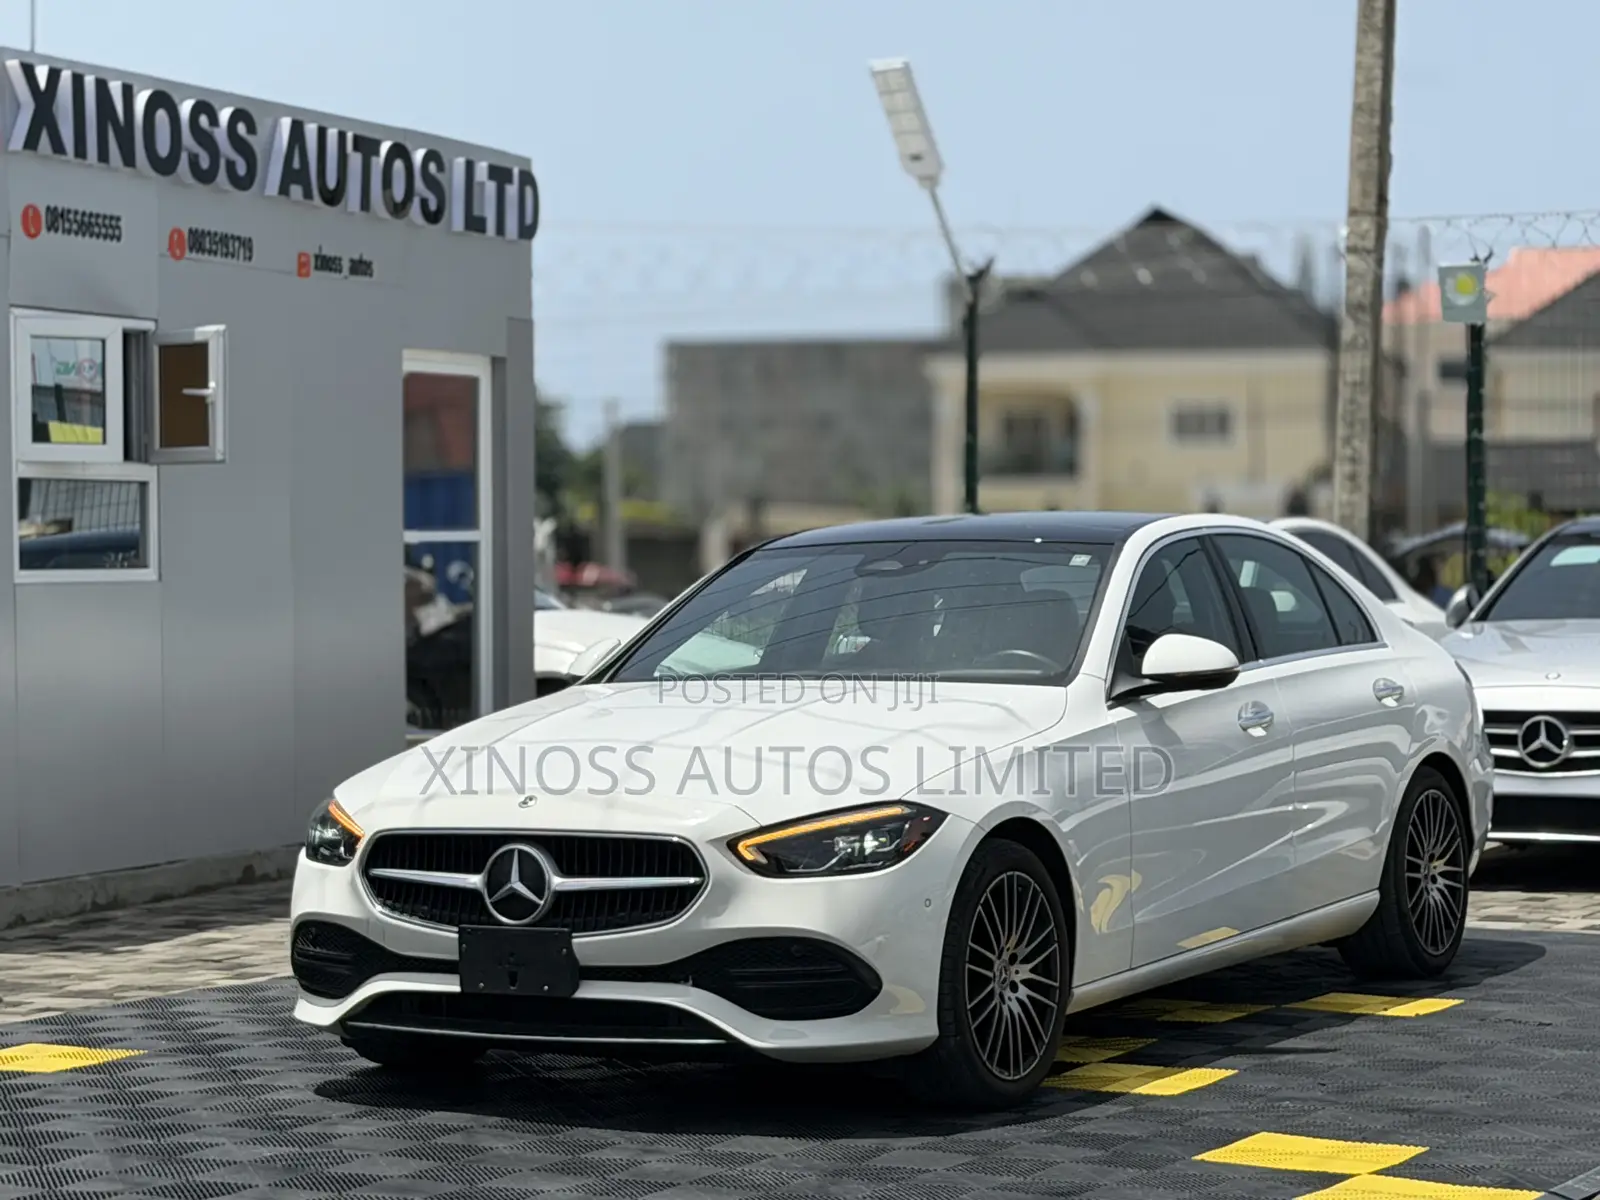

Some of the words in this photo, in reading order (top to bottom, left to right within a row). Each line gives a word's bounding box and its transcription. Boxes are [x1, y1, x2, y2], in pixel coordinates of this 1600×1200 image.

[6, 60, 258, 191] XINOSS
[265, 117, 446, 226] AUTOS
[452, 157, 539, 241] LTD
